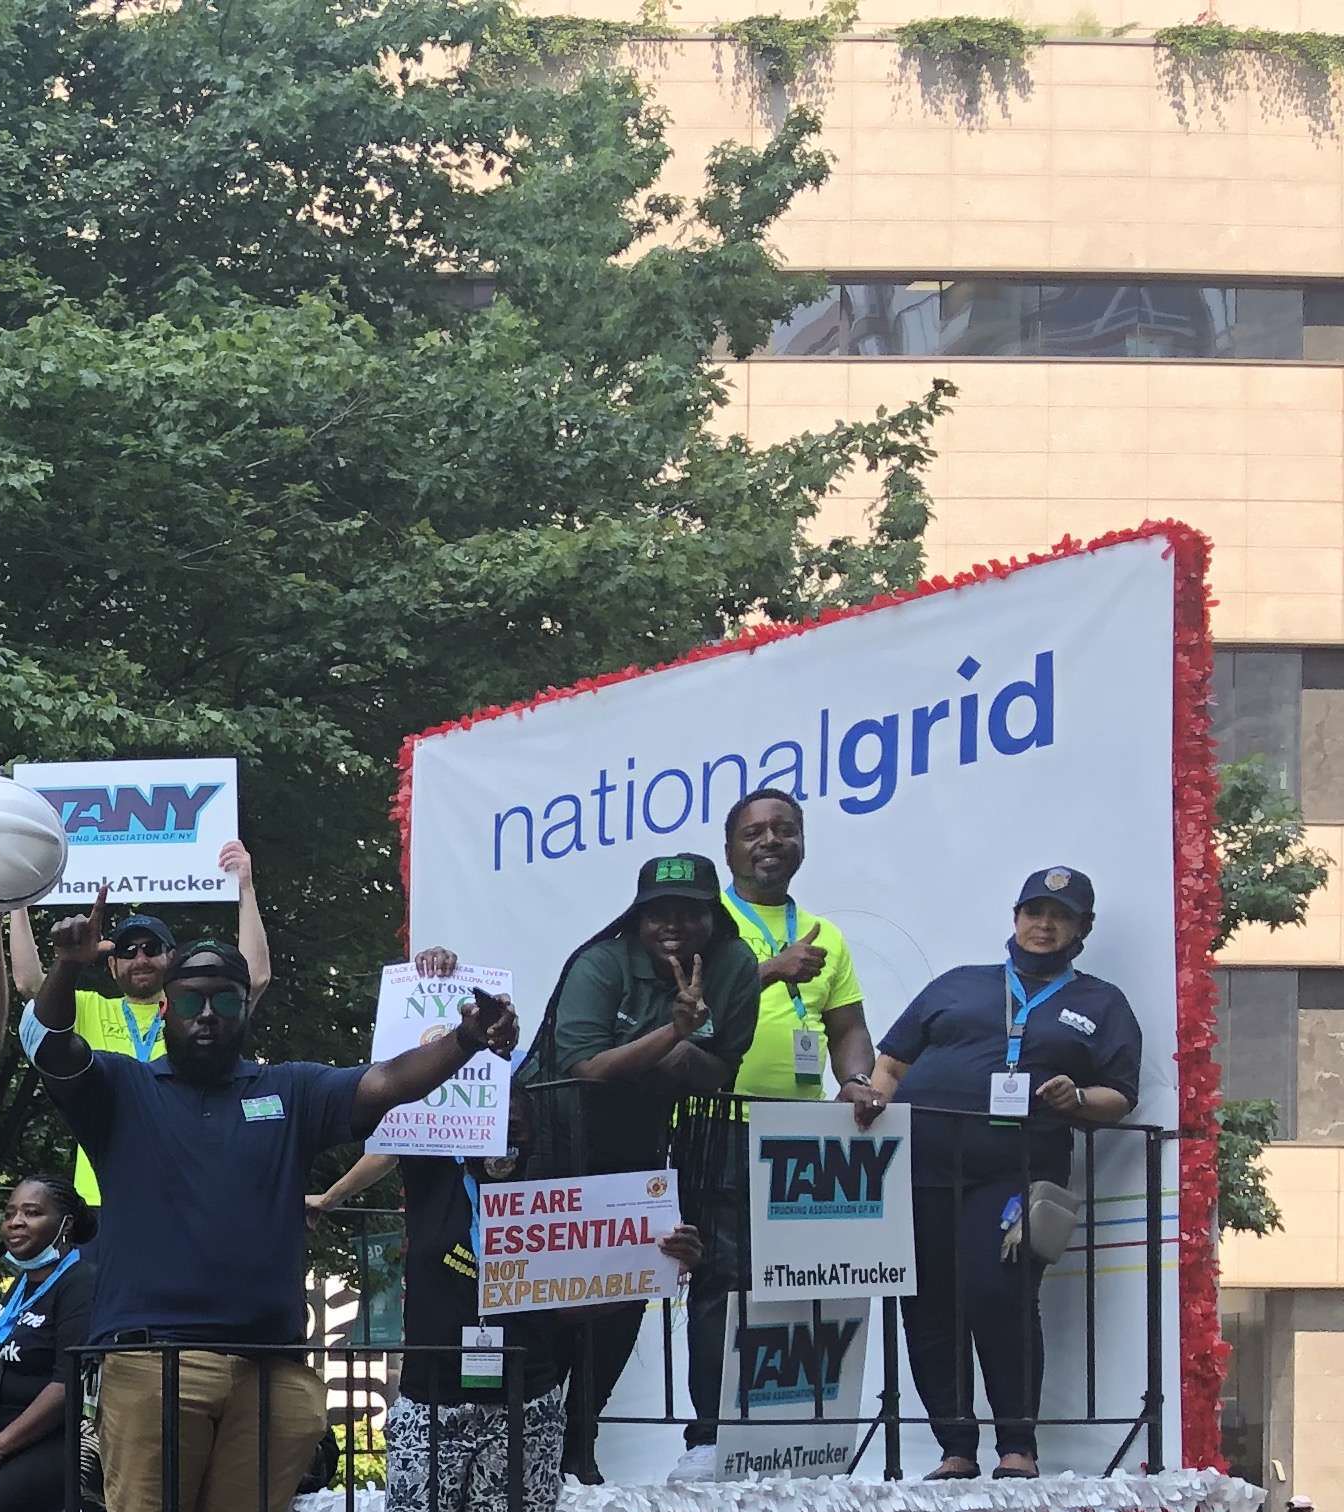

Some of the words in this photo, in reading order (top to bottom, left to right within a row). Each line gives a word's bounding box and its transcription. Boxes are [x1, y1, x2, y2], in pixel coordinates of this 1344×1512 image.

[493, 650, 1054, 872] nationalgrid
[92, 833, 160, 842] ASSOCIATION
[178, 832, 193, 840] NY
[50, 874, 226, 894] hankATrucker
[411, 981, 474, 996] Across
[421, 1083, 498, 1110] ONE
[383, 1112, 437, 1125] RIVER
[442, 1114, 496, 1127] POWER
[428, 1127, 492, 1141] POWER
[759, 1136, 903, 1203] TANY
[483, 1191, 526, 1218] WE
[530, 1187, 583, 1215] ARE
[770, 1205, 807, 1216] TRUCKING
[808, 1205, 857, 1215] ASSOCIATION
[858, 1204, 869, 1214] OF
[869, 1204, 880, 1214] NY
[484, 1215, 657, 1256] ESSENTIAL
[484, 1258, 529, 1283] NOT
[763, 1261, 907, 1288] #ThankATrucker
[482, 1269, 661, 1309] EXPENDABLE.
[773, 1389, 815, 1401] ASSOCIATIO
[724, 1442, 849, 1475] #ThankATrucker
